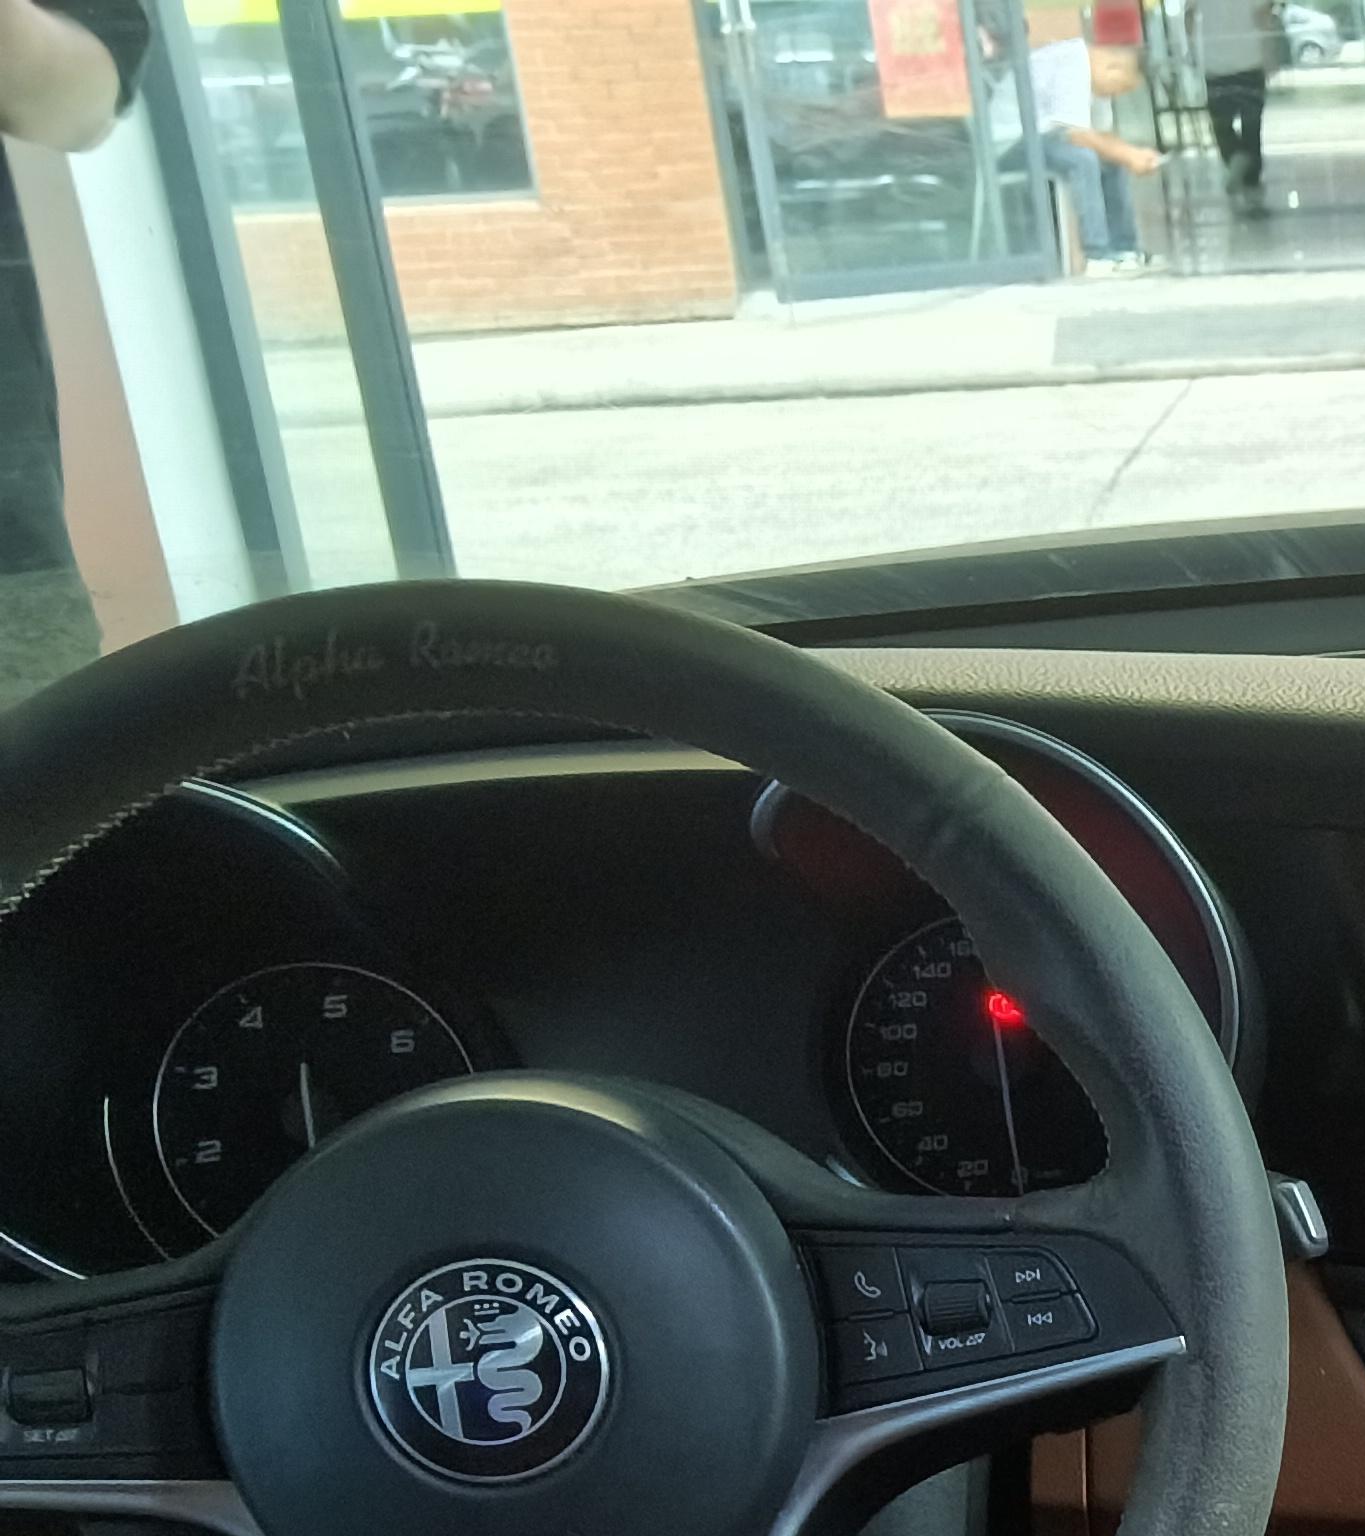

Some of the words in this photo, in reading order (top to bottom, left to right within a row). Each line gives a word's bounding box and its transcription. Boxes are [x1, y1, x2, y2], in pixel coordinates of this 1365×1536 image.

[913, 962, 952, 979] 140
[323, 994, 349, 1019] 5
[888, 990, 928, 1008] 120
[239, 1005, 264, 1030] 4
[880, 1023, 918, 1041] 100
[390, 1029, 415, 1054] 6
[193, 1065, 219, 1091] 3
[876, 1061, 909, 1078] 80
[891, 1100, 924, 1118] 60
[194, 1139, 222, 1164] 2
[918, 1134, 949, 1151] 40
[957, 1159, 989, 1178] 20
[380, 1288, 444, 1381] ALFA
[462, 1270, 592, 1363] ROMEO
[938, 1337, 965, 1350] VOL
